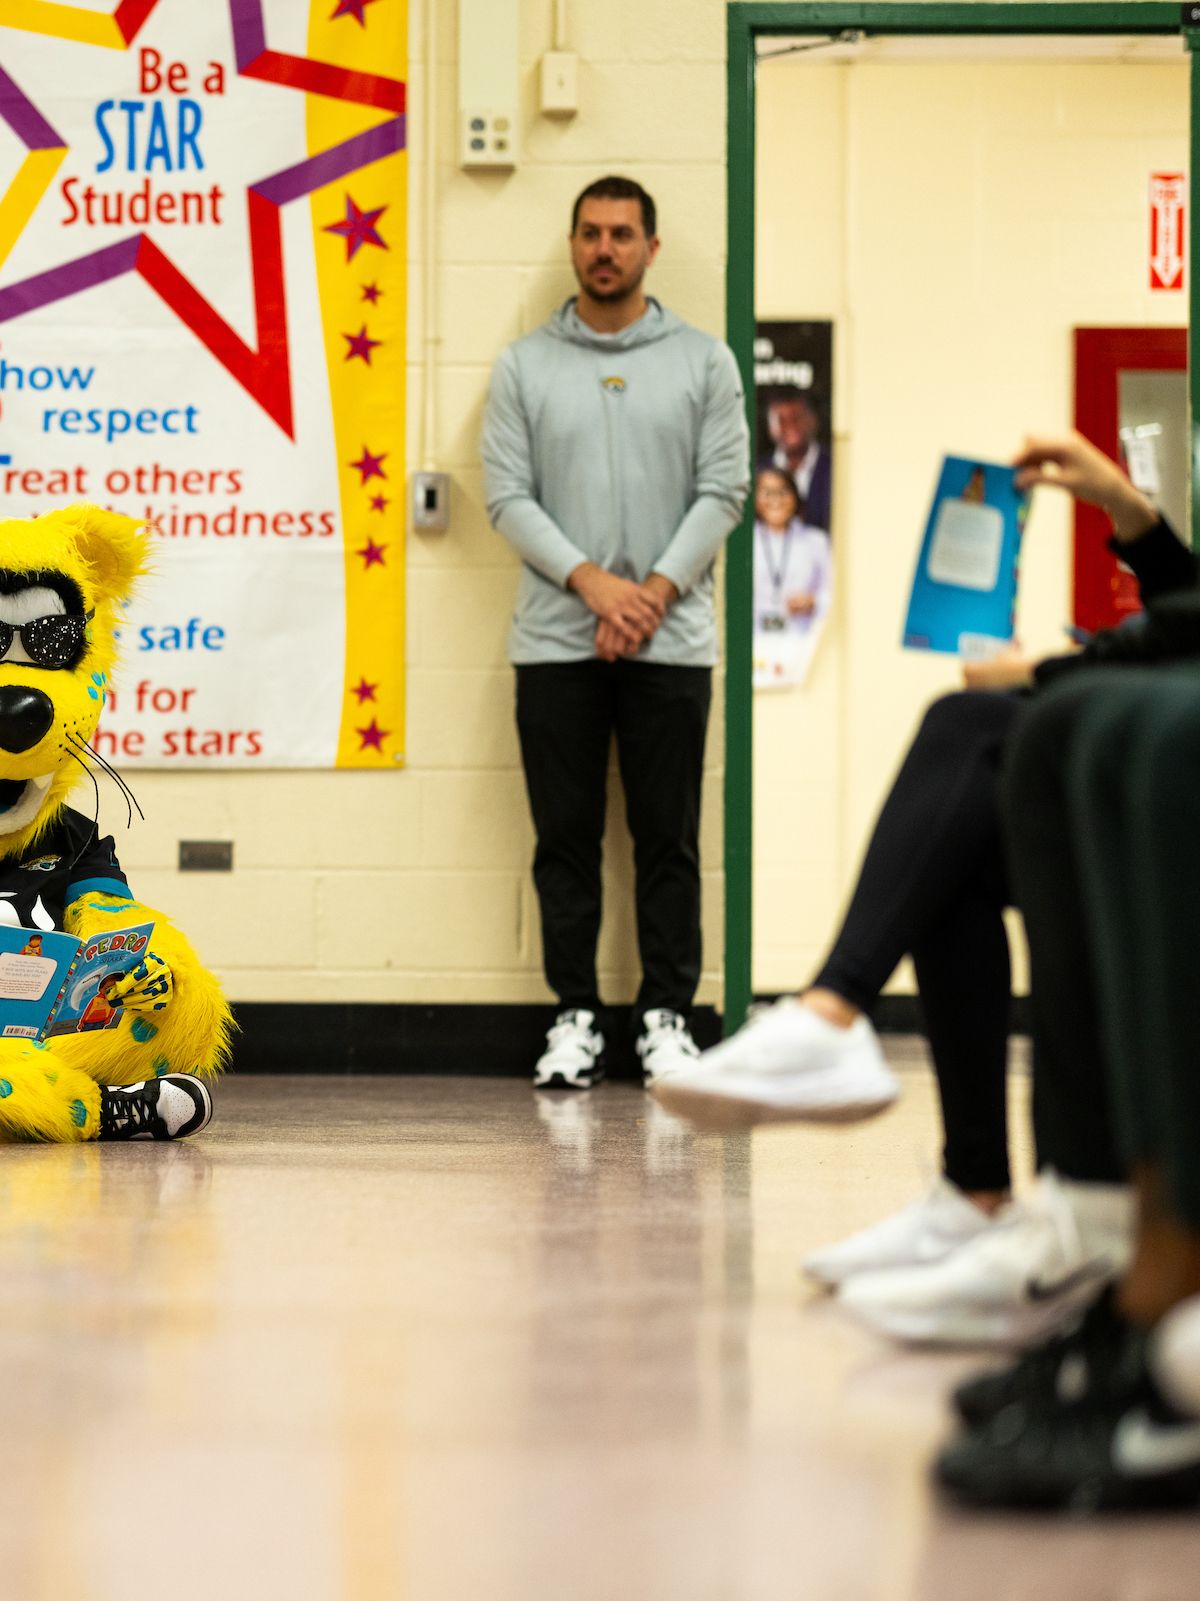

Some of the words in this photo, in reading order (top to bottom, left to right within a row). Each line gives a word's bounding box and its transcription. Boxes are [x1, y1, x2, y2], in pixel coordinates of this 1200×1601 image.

[139, 47, 188, 94] Be
[204, 61, 225, 94] a
[94, 100, 204, 173] STAR
[61, 177, 224, 226] Student
[42, 405, 200, 443] respect
[104, 463, 244, 495] others
[144, 505, 336, 538] kindness
[138, 617, 226, 651] safe
[135, 679, 197, 714] for
[91, 724, 145, 756] he
[162, 726, 263, 756] stars
[84, 932, 148, 963] PEDRO
